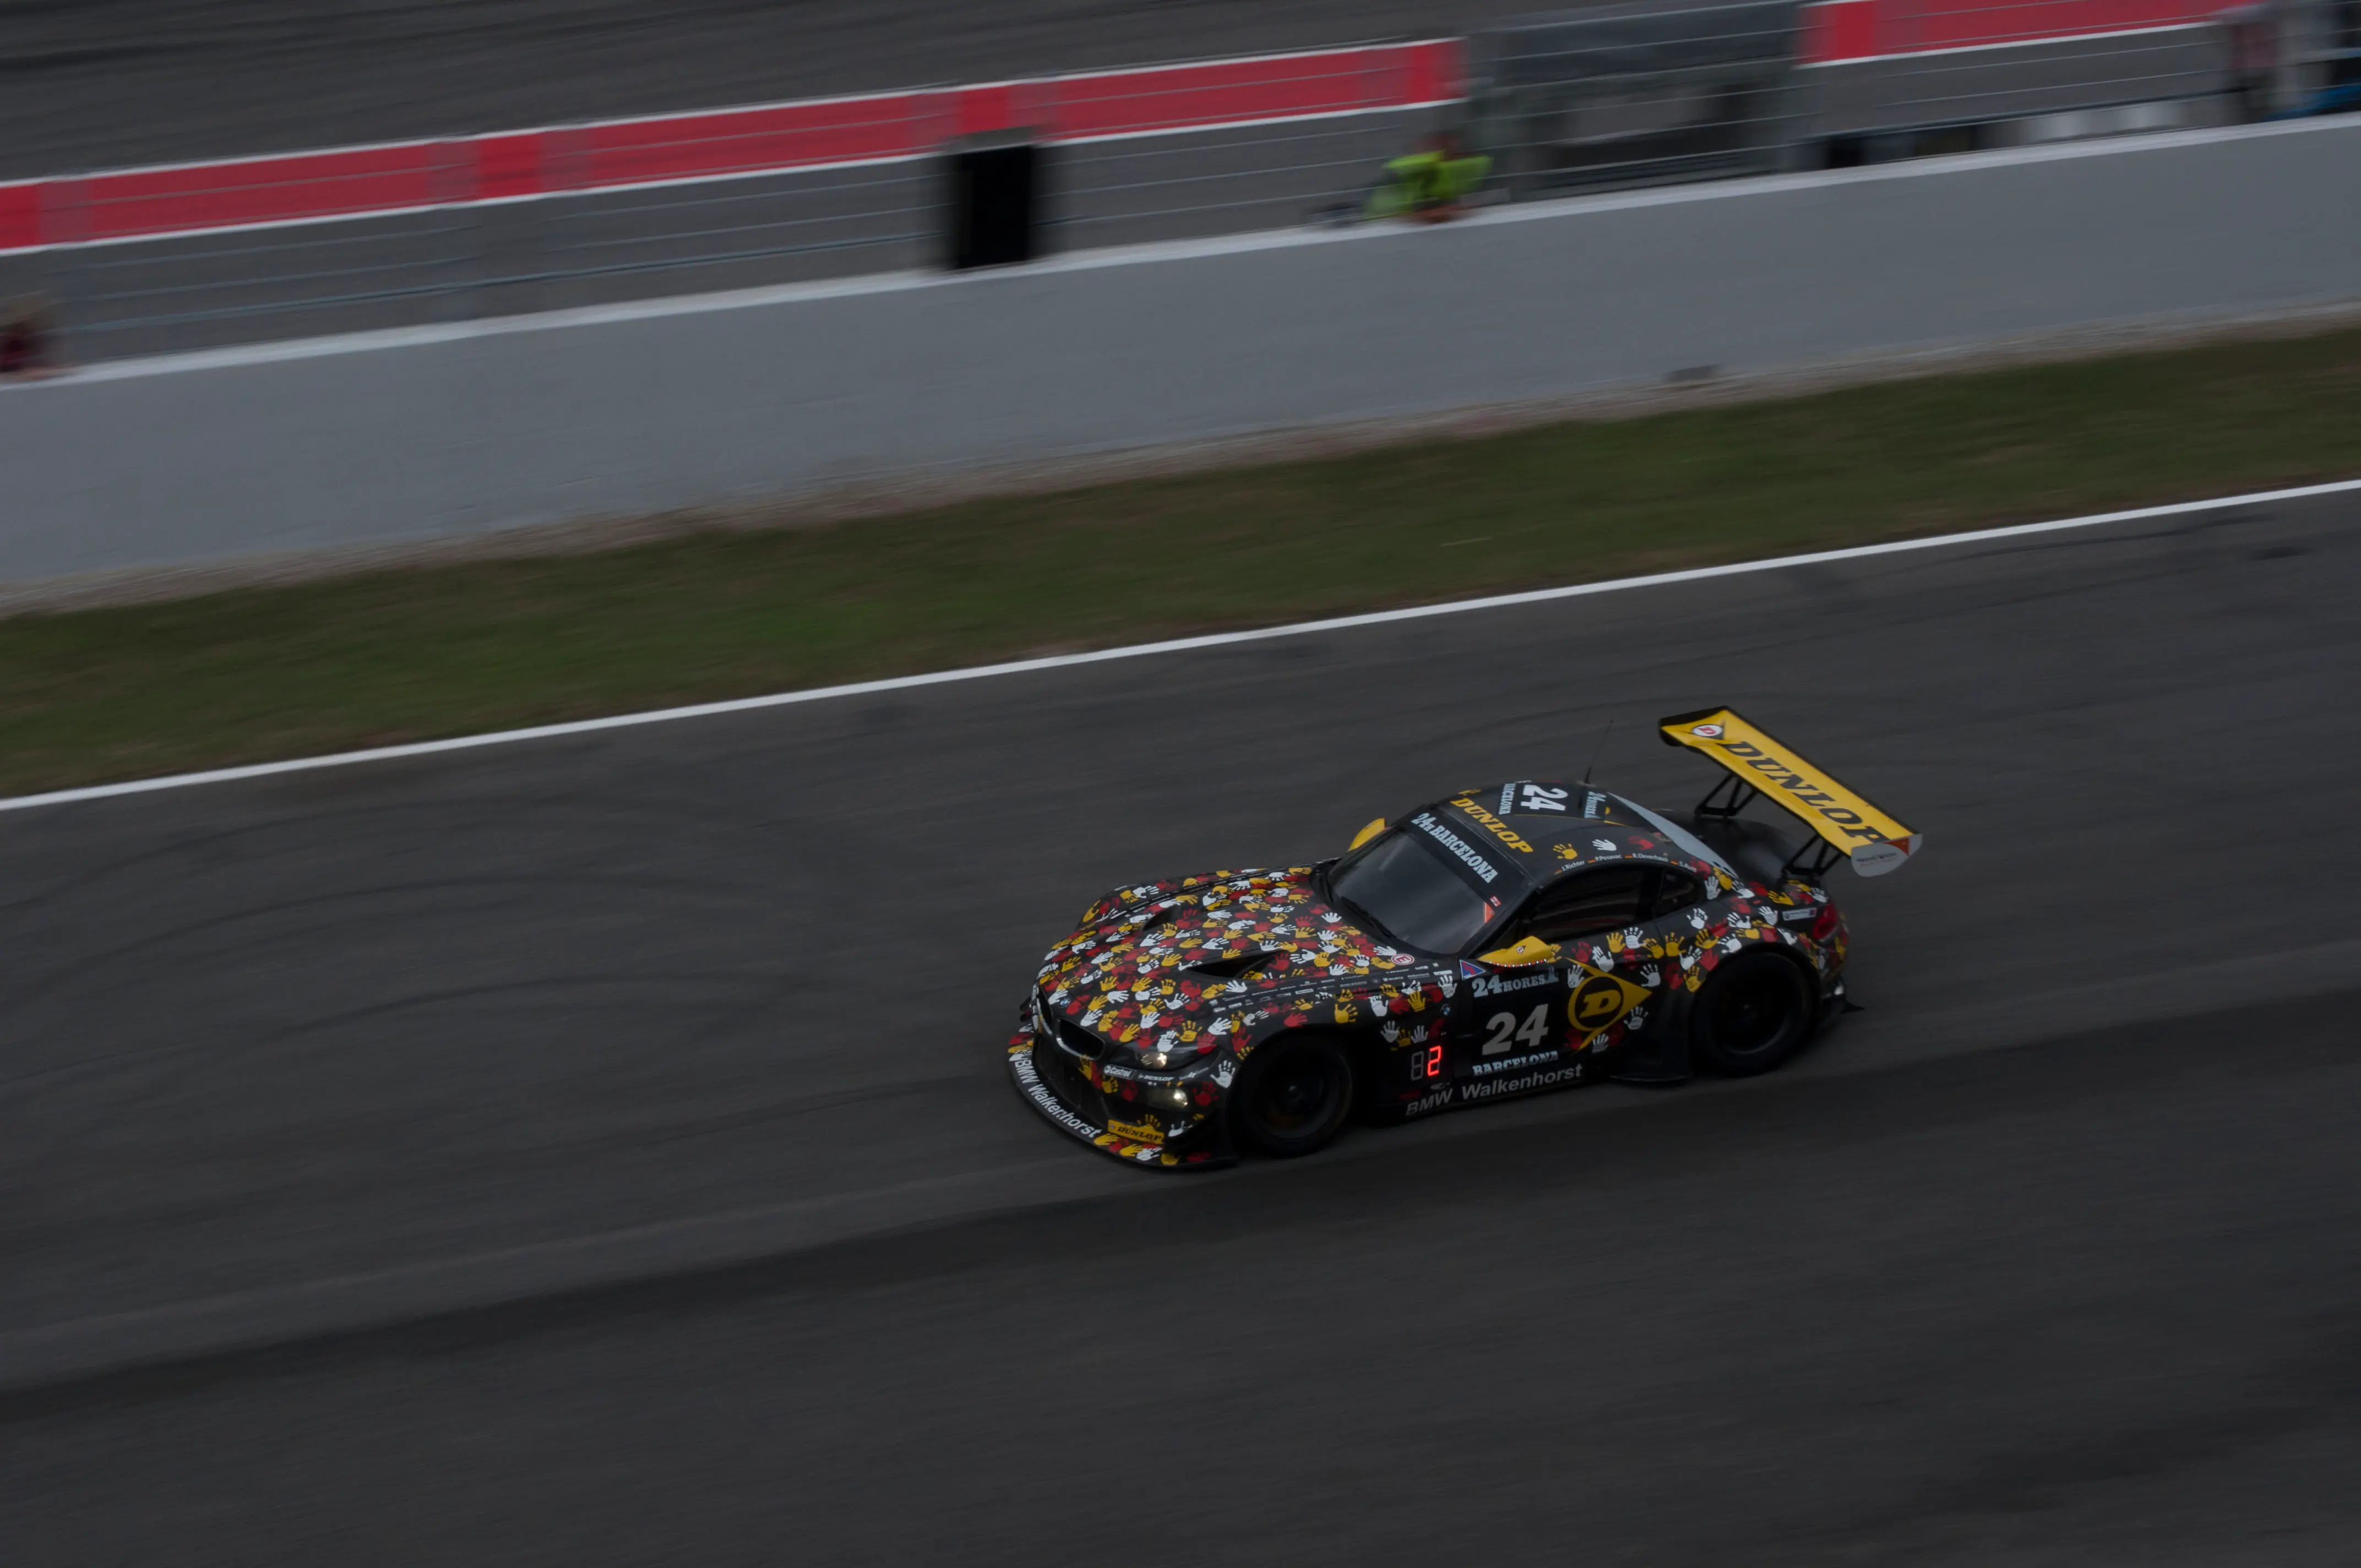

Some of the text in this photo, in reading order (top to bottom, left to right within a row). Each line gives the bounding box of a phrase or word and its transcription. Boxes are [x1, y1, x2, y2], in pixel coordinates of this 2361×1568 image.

[1520, 784, 1569, 811] 24
[1715, 741, 1890, 844] DUNLOP
[1450, 798, 1533, 853] DUNLOP
[1429, 825, 1498, 883] BARCELONA
[1482, 1003, 1549, 1055] 24
[1579, 989, 1622, 1018] D
[1405, 1062, 1584, 1116] BMW Walkenhorst
[1472, 1050, 1559, 1076] BARCELONA
[1015, 1058, 1103, 1137] BMW Walkenhorst
[1118, 1126, 1162, 1140] DUNLOP
